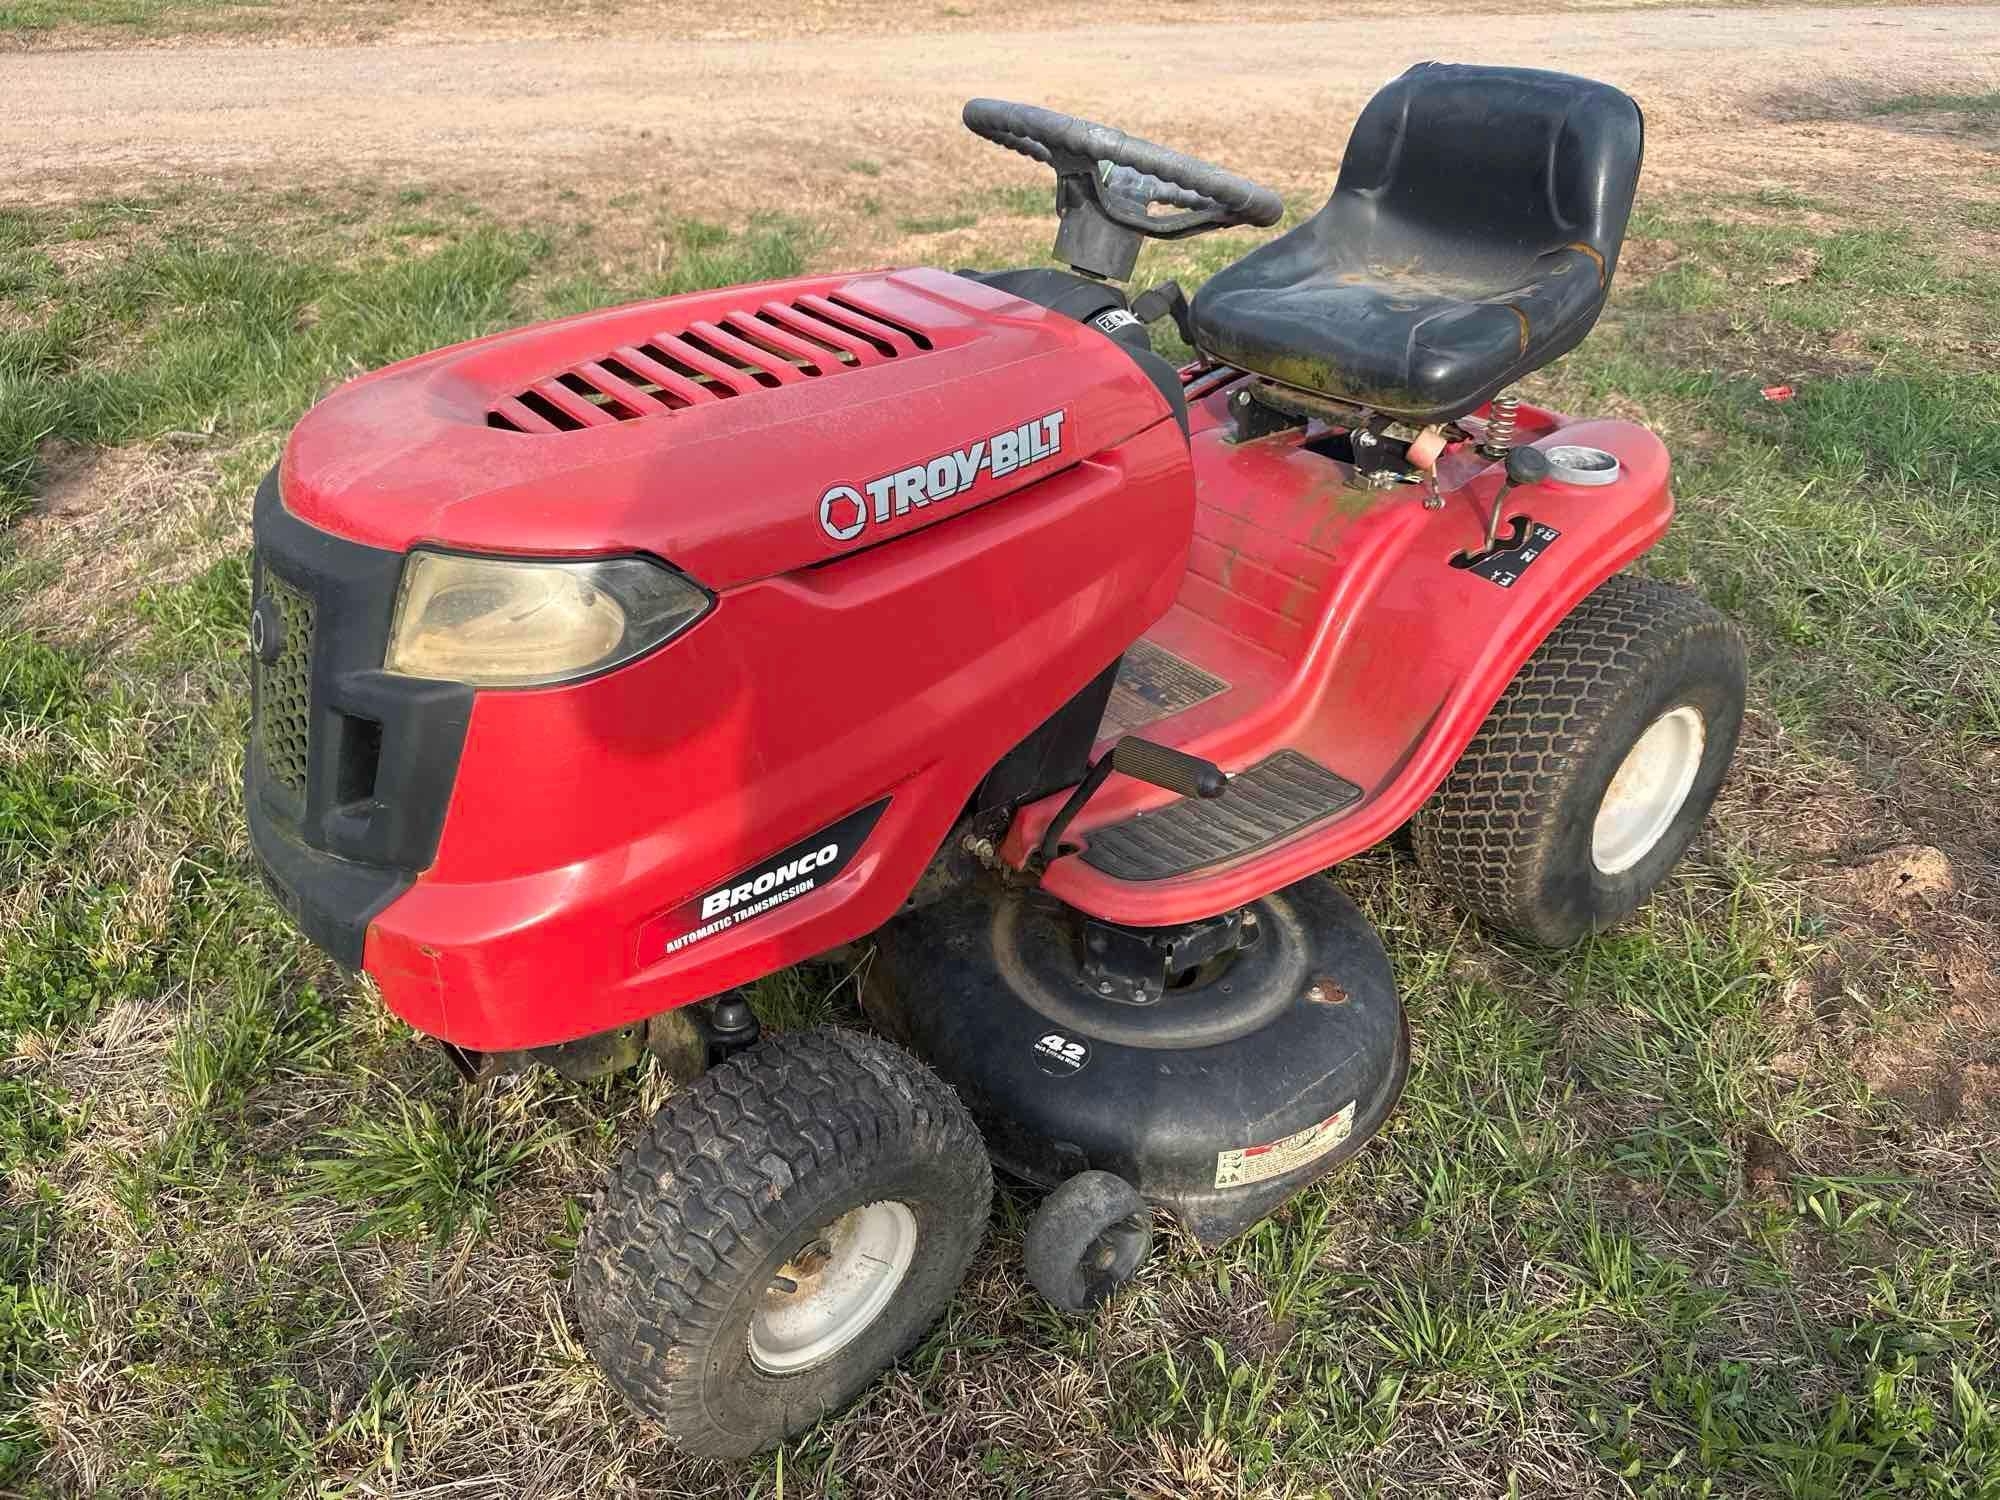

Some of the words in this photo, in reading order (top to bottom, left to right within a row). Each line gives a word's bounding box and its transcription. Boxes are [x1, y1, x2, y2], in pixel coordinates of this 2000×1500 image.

[865, 409, 1065, 523] TROY-BILT
[1541, 531, 1556, 541] R
[1520, 550, 1535, 562] N
[1498, 576, 1512, 587] F
[701, 843, 839, 920] BRONCO
[665, 915, 733, 953] AUTOMATIC
[732, 878, 815, 923] TRANSMISSION
[1041, 1034, 1086, 1061] 42
